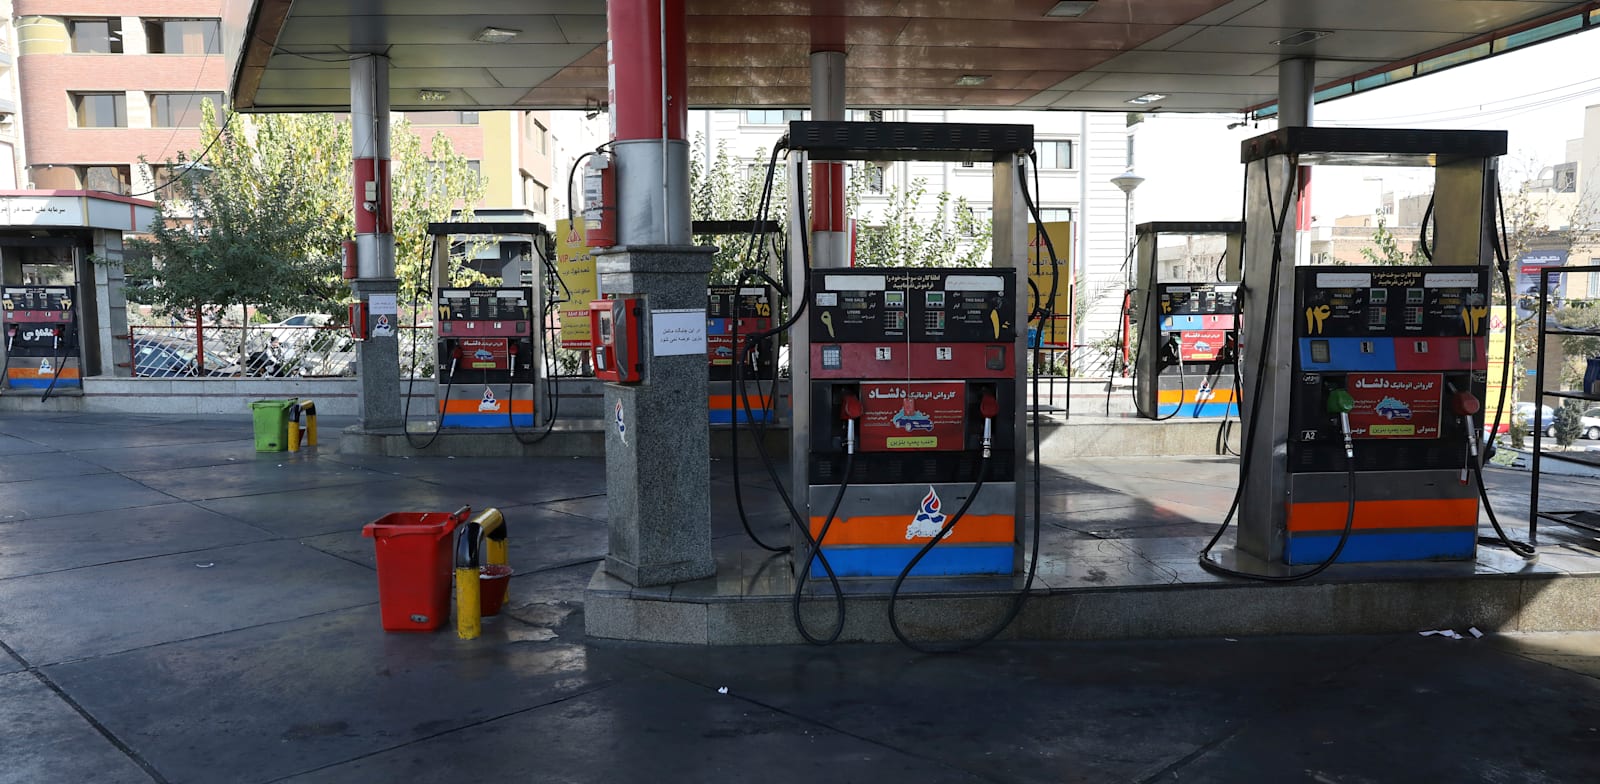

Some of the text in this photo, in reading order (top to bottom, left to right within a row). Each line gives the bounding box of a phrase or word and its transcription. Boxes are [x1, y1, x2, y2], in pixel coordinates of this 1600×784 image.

[560, 254, 568, 263] VIP
[1305, 304, 1331, 335] ۱۴
[1461, 305, 1488, 335] ۱۳
[1355, 377, 1434, 391] کارواش اتوماتیک دلشاد
[869, 386, 956, 400] کارواش اتوماتیک دلشاد
[1305, 431, 1315, 440] A2
[1416, 426, 1437, 434] معمولی
